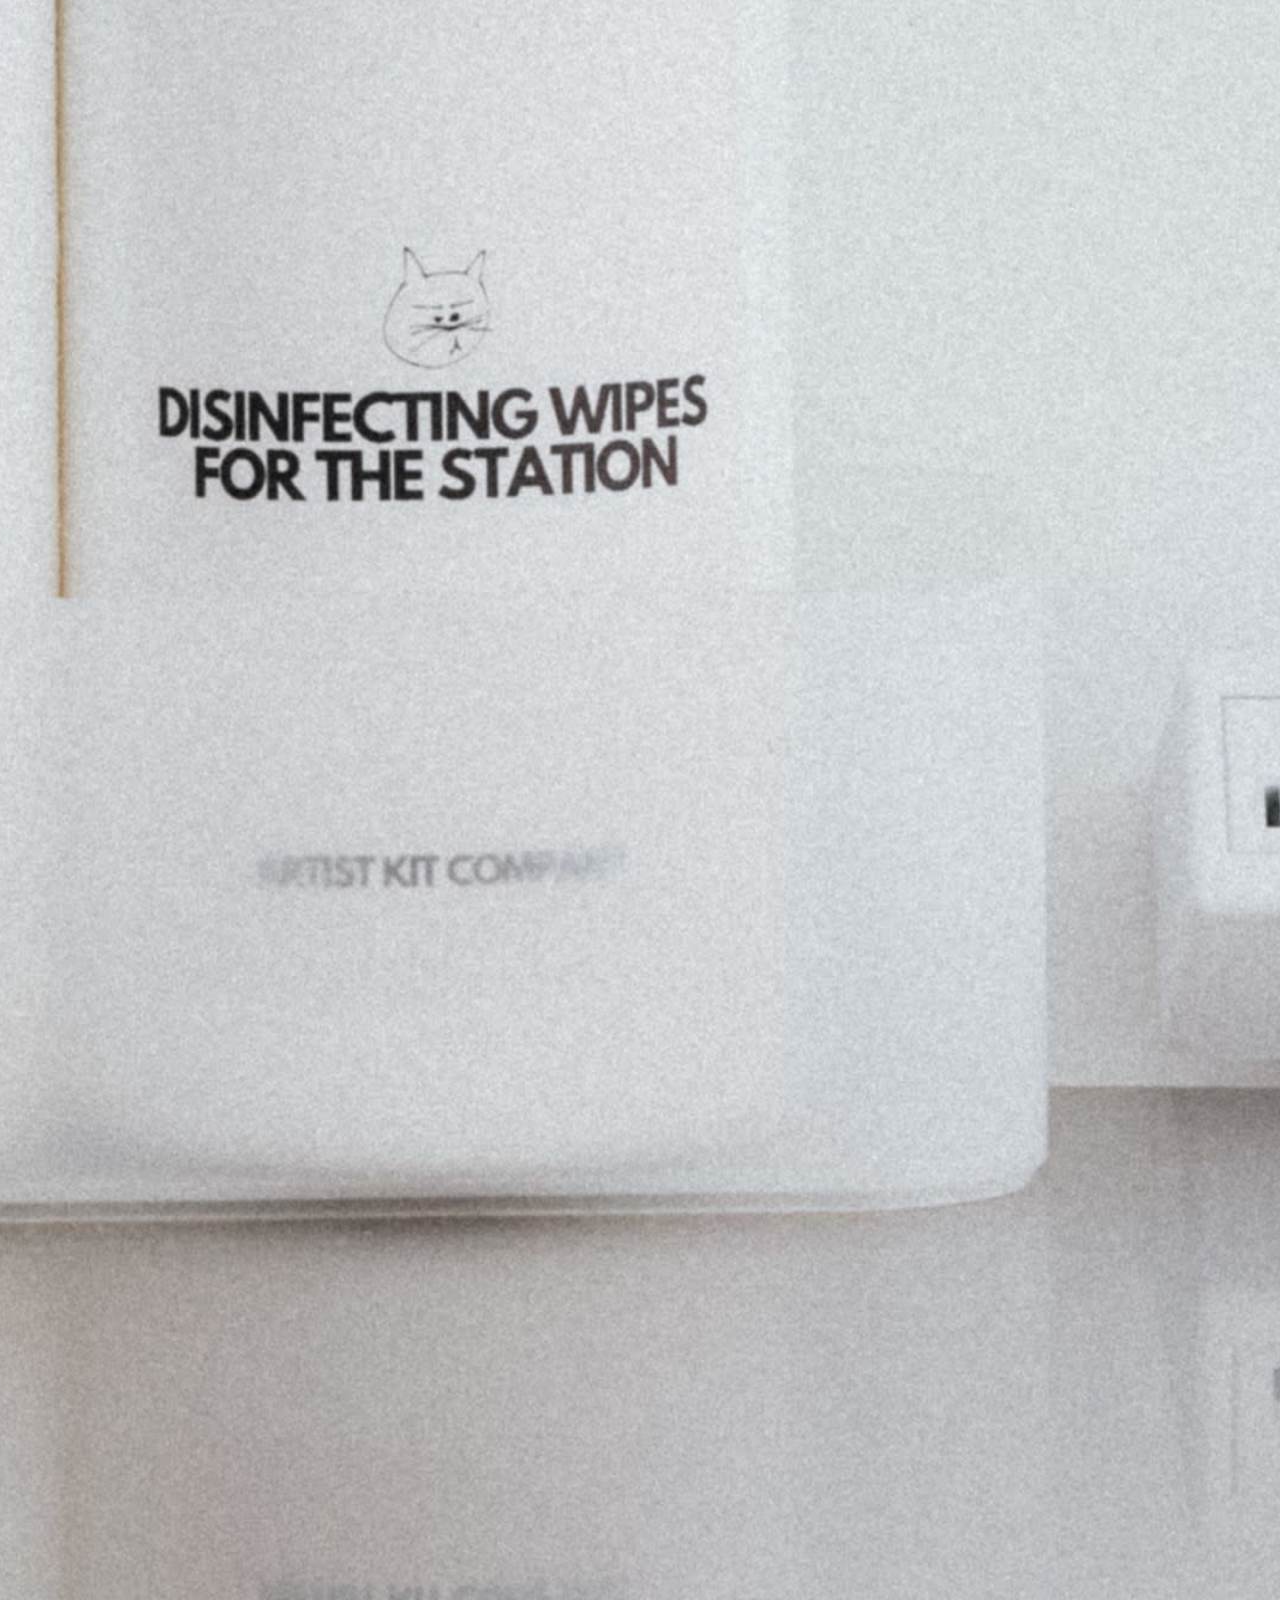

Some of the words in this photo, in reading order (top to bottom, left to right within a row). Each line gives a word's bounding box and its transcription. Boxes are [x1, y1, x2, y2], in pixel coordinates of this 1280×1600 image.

[158, 386, 539, 443] DISINFECTING
[548, 374, 709, 436] WIPES
[195, 446, 306, 501] FOR
[315, 449, 425, 502] THE
[437, 435, 678, 500] STATION
[260, 854, 375, 888] RTIST
[382, 854, 439, 887] KIT
